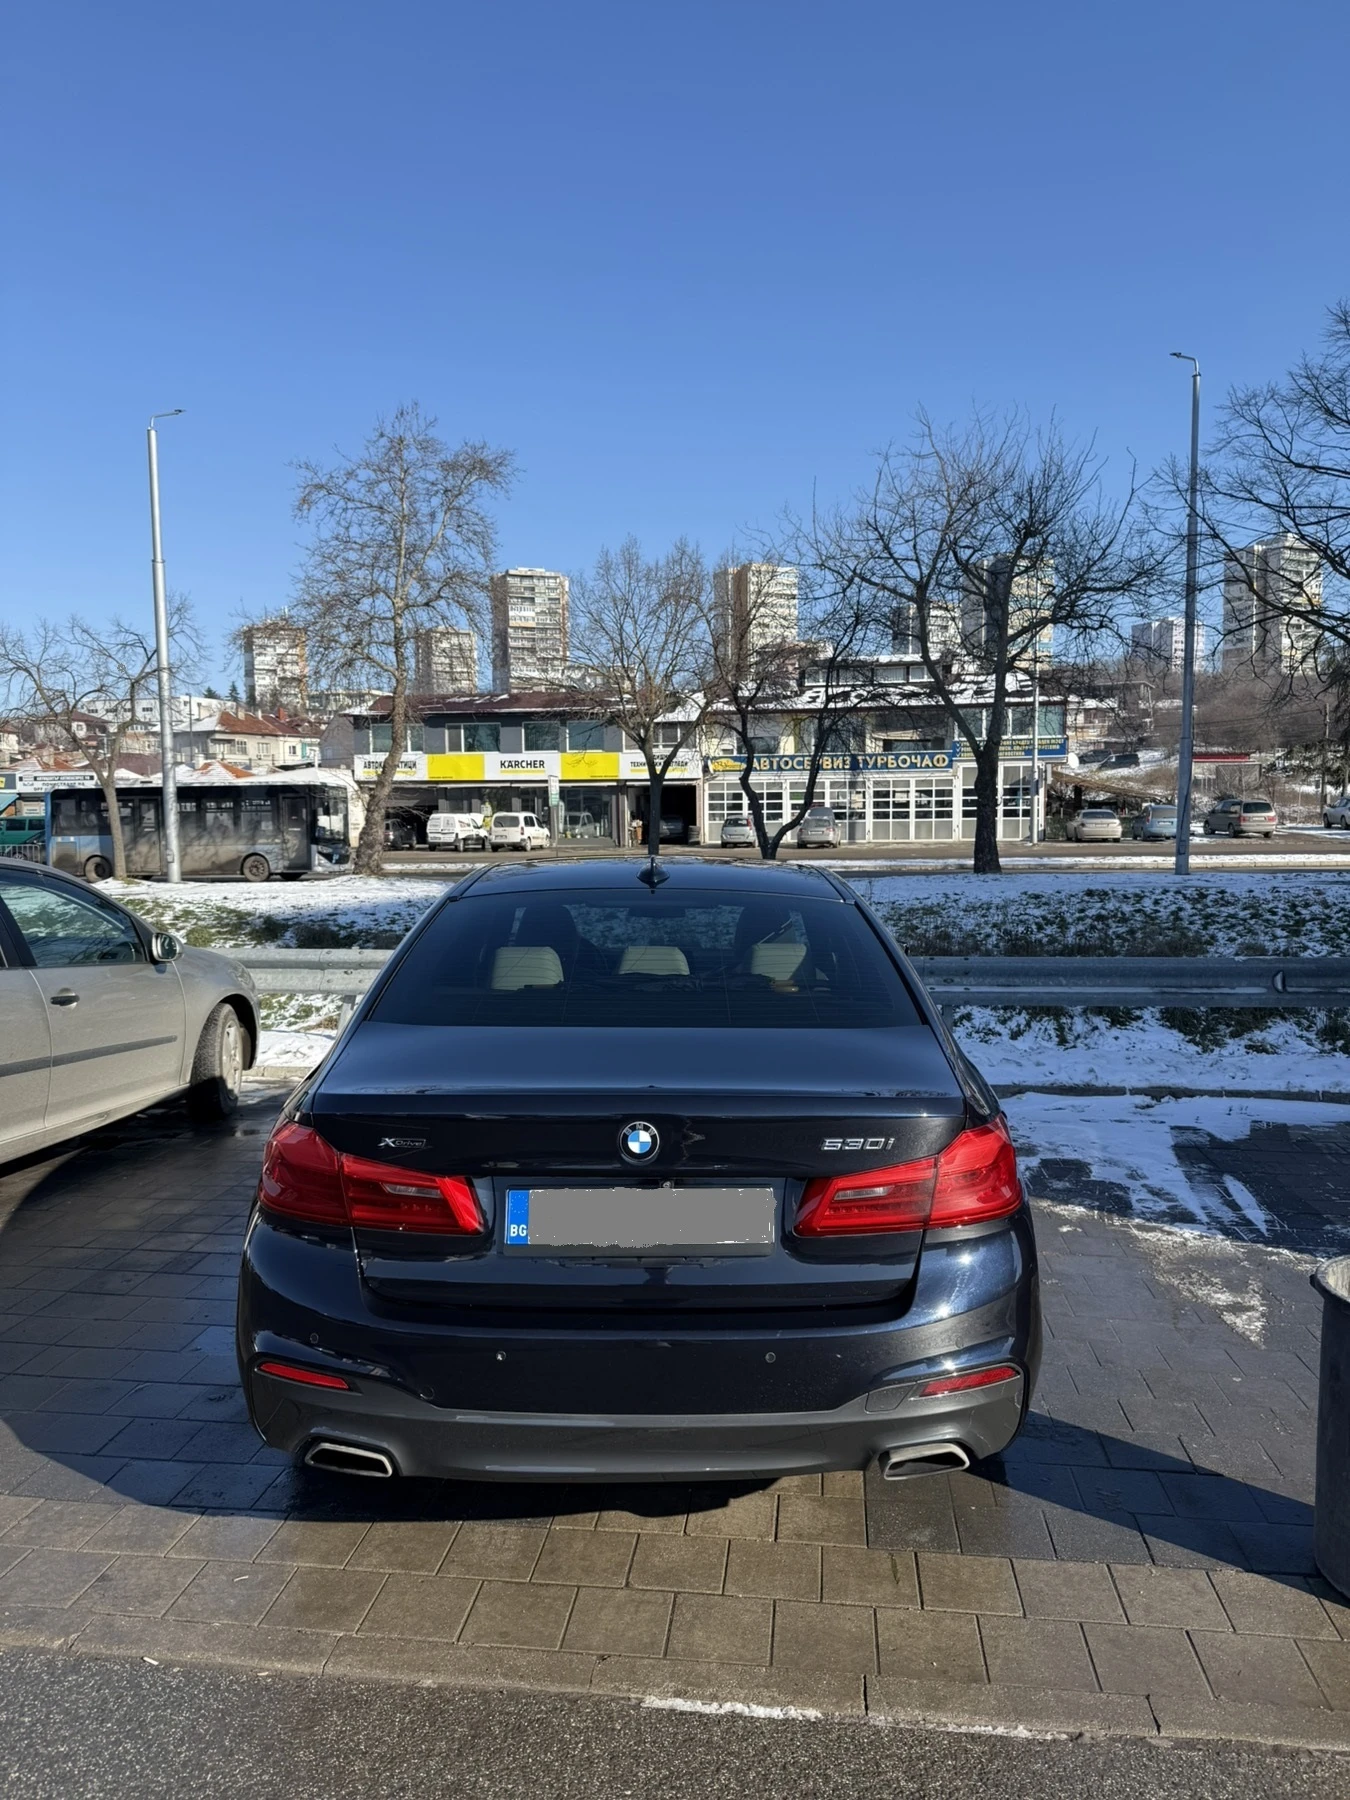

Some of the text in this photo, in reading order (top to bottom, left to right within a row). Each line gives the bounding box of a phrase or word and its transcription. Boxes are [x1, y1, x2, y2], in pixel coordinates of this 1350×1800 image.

[363, 760, 417, 770] АВТОКАТИЦИ
[500, 759, 545, 769] KÄRCHER
[857, 754, 949, 769] ТУРБОЧАФ
[624, 1122, 656, 1136] BMW
[821, 1137, 895, 1151] 530i
[510, 1223, 527, 1237] BG
